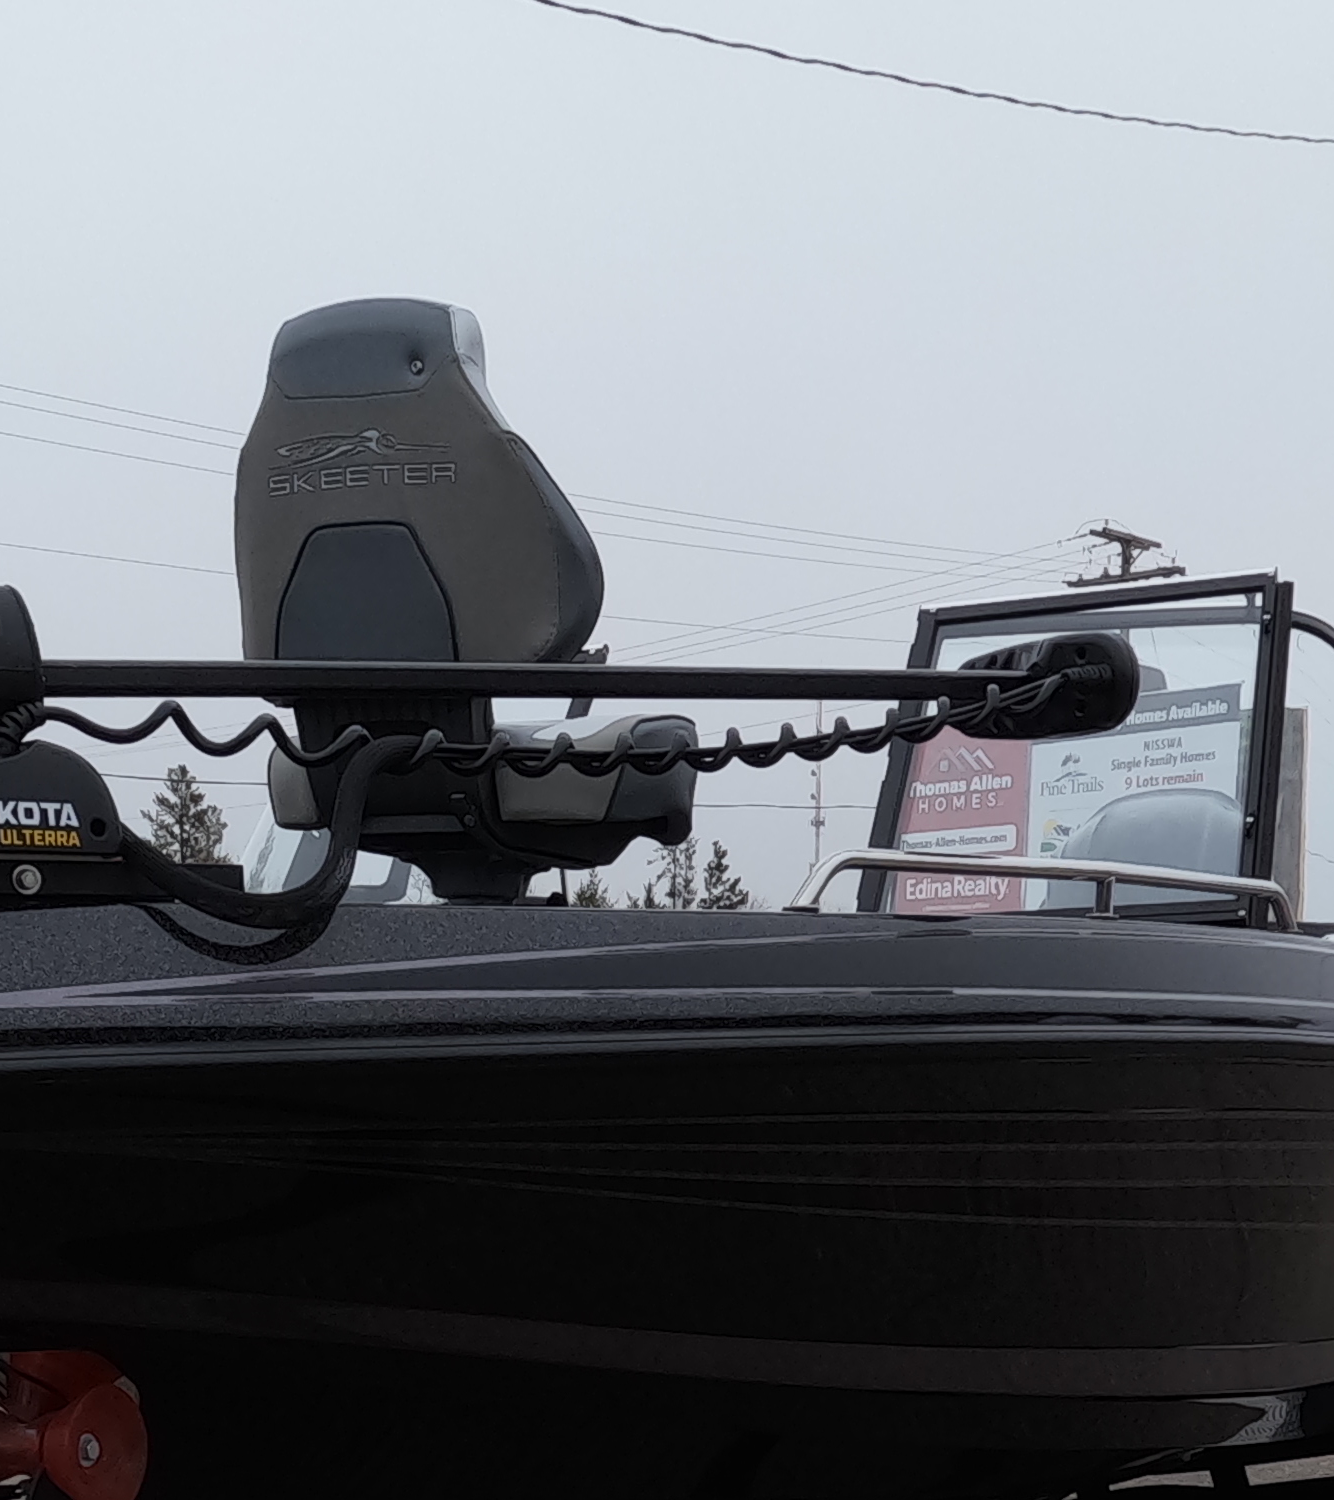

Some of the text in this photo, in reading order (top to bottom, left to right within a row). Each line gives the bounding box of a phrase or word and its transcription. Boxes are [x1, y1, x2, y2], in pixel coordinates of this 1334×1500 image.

[268, 462, 457, 497] SKEETER
[1126, 699, 1229, 726] Homes Available
[1144, 736, 1183, 752] NISSWA
[1111, 750, 1216, 773] Single Family Homes
[909, 773, 1013, 798] Thomas Allen
[1125, 770, 1204, 790] 9 Lots remain
[918, 792, 997, 814] HOMES
[0, 828, 82, 848] ULTERRA
